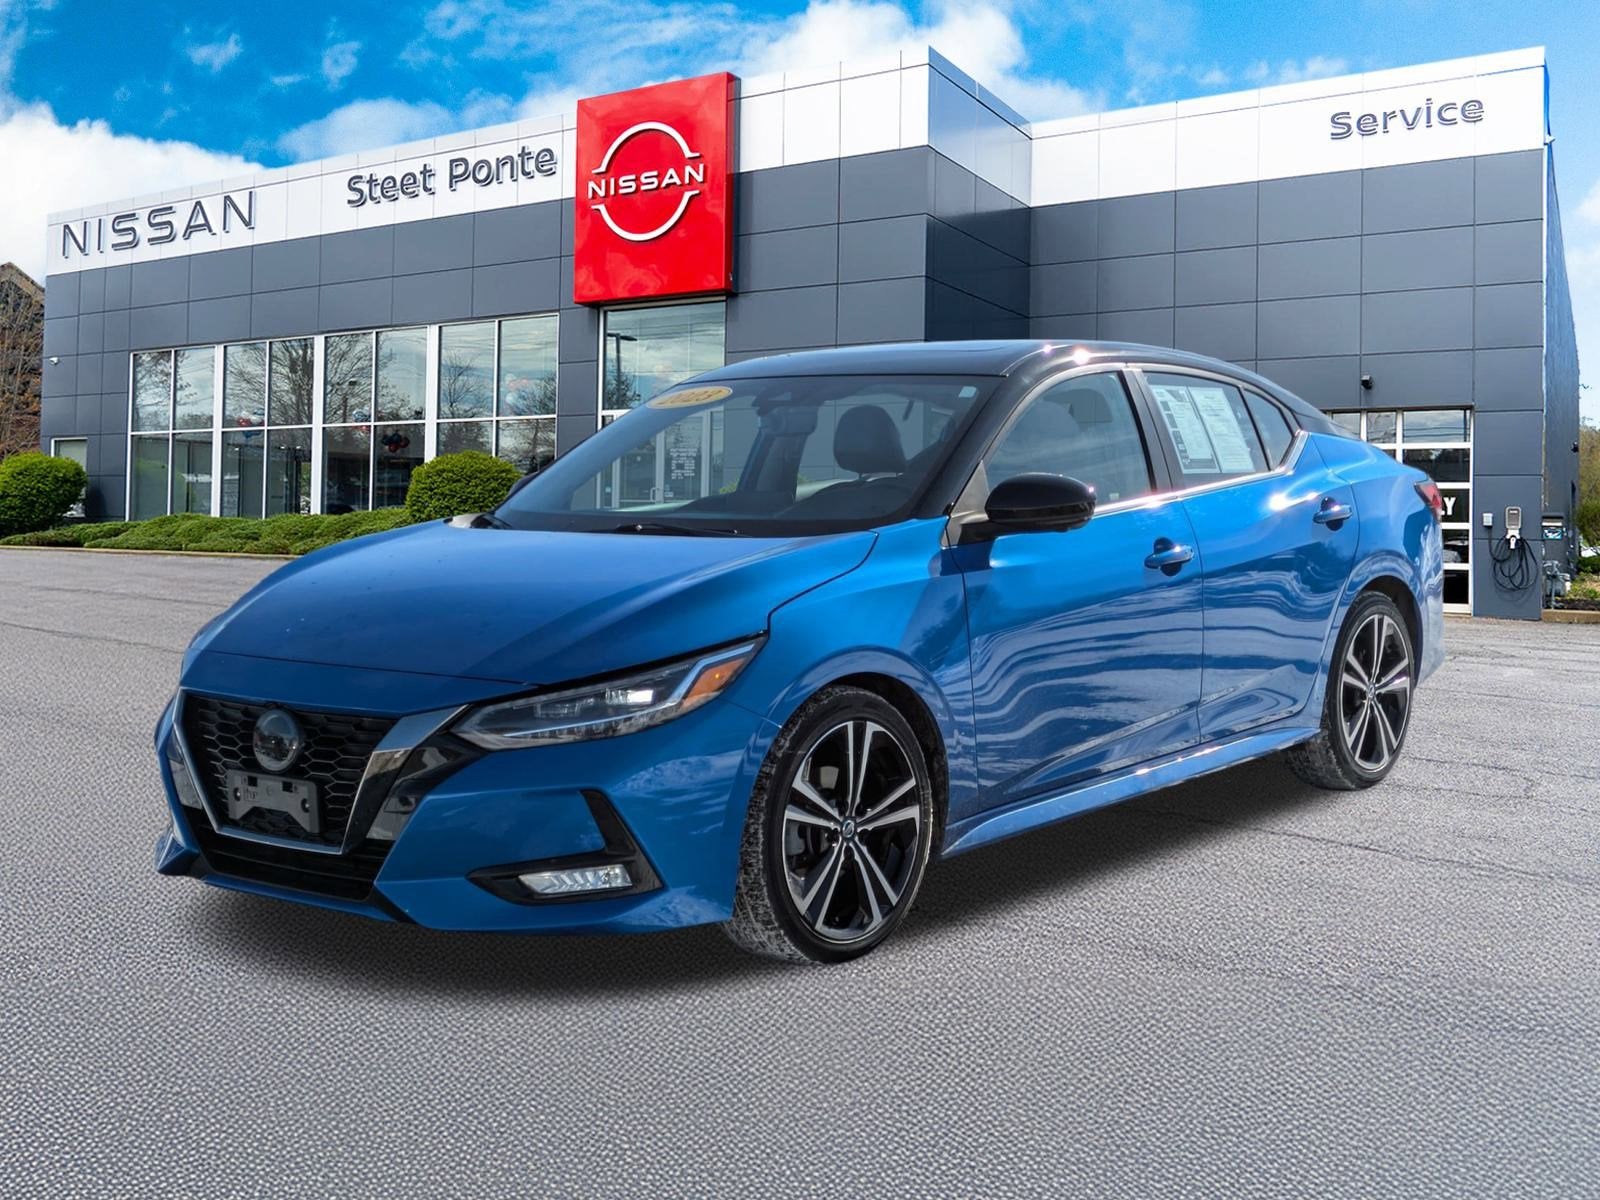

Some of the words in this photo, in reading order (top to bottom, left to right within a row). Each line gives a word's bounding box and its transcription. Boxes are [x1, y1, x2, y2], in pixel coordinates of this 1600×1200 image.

[1330, 97, 1485, 140] Service
[346, 162, 437, 208] Steet
[448, 145, 558, 192] Ponte
[587, 163, 705, 200] NISSAN
[62, 190, 256, 260] NISSAN
[1441, 497, 1457, 516] Y
